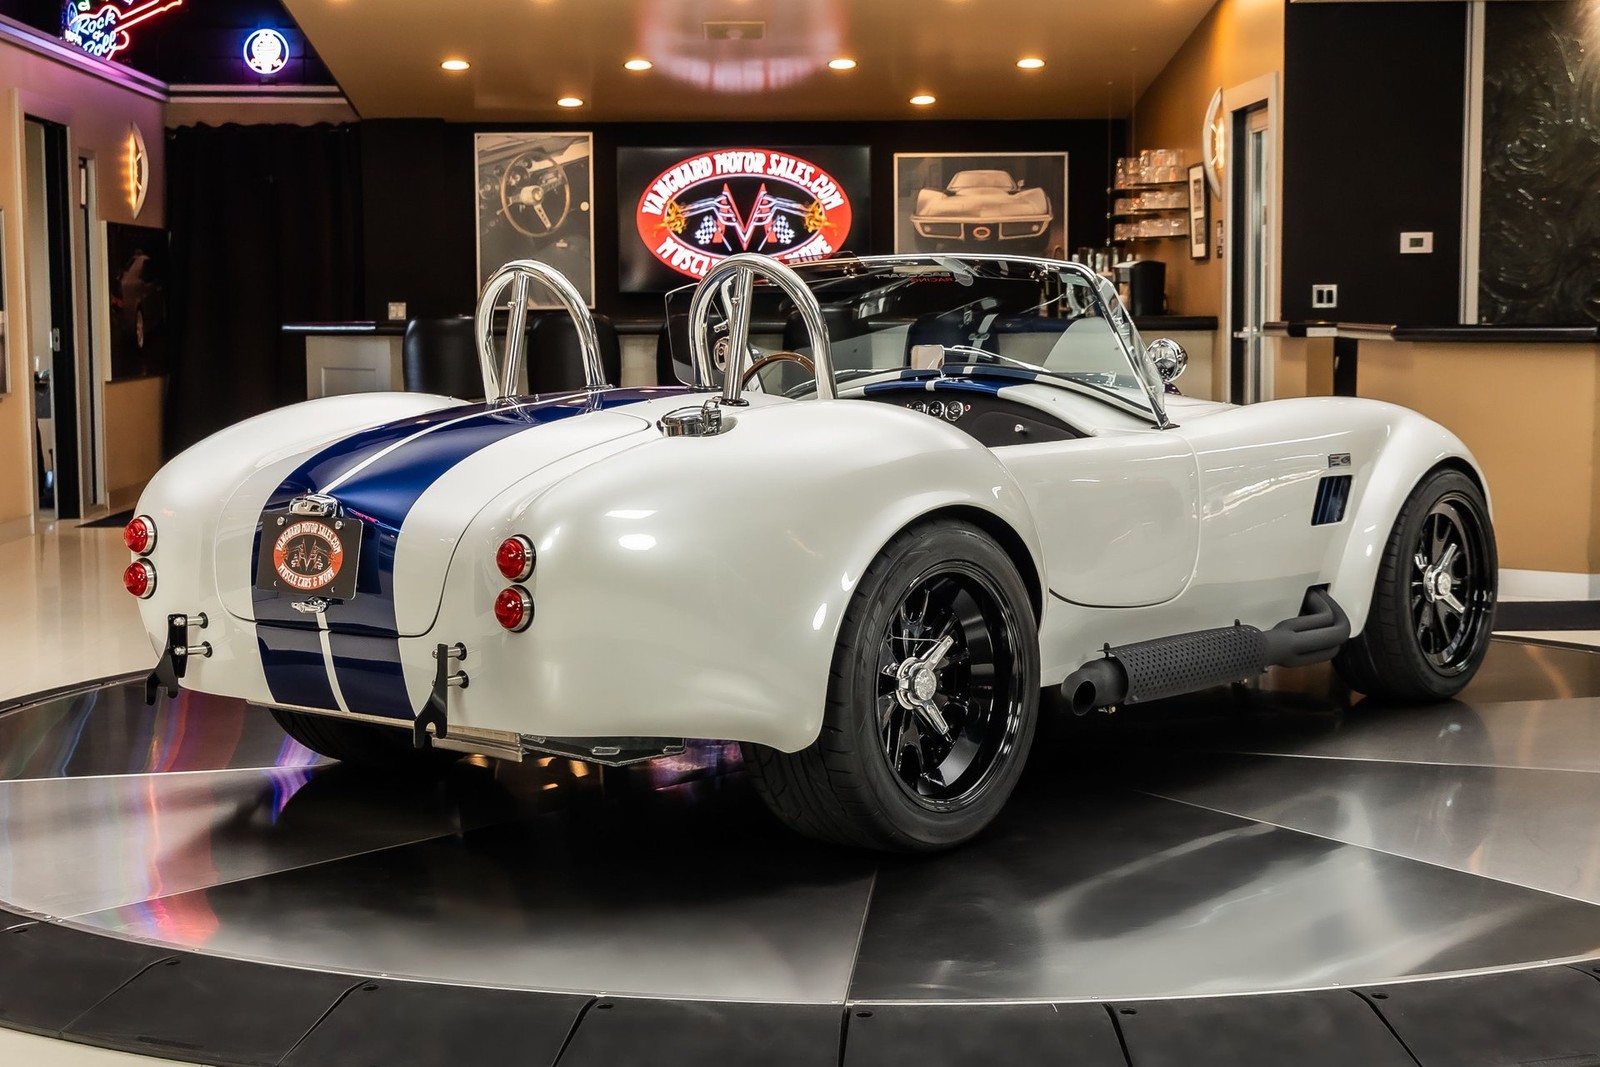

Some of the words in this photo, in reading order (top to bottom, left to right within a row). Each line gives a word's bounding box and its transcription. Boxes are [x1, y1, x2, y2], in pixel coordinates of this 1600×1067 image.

[76, 8, 116, 35] Rock
[642, 156, 713, 215] VANGUARD
[713, 151, 766, 175] MOTOR
[767, 153, 844, 211] SALES.COM
[656, 236, 720, 278] MUSCL
[276, 524, 301, 551] VANGUARD
[301, 522, 318, 533] MOTOR
[318, 525, 341, 554] SALES.COM
[278, 563, 299, 585] MUSCLE
[298, 576, 312, 588] CARS
[318, 567, 335, 586] MORE
